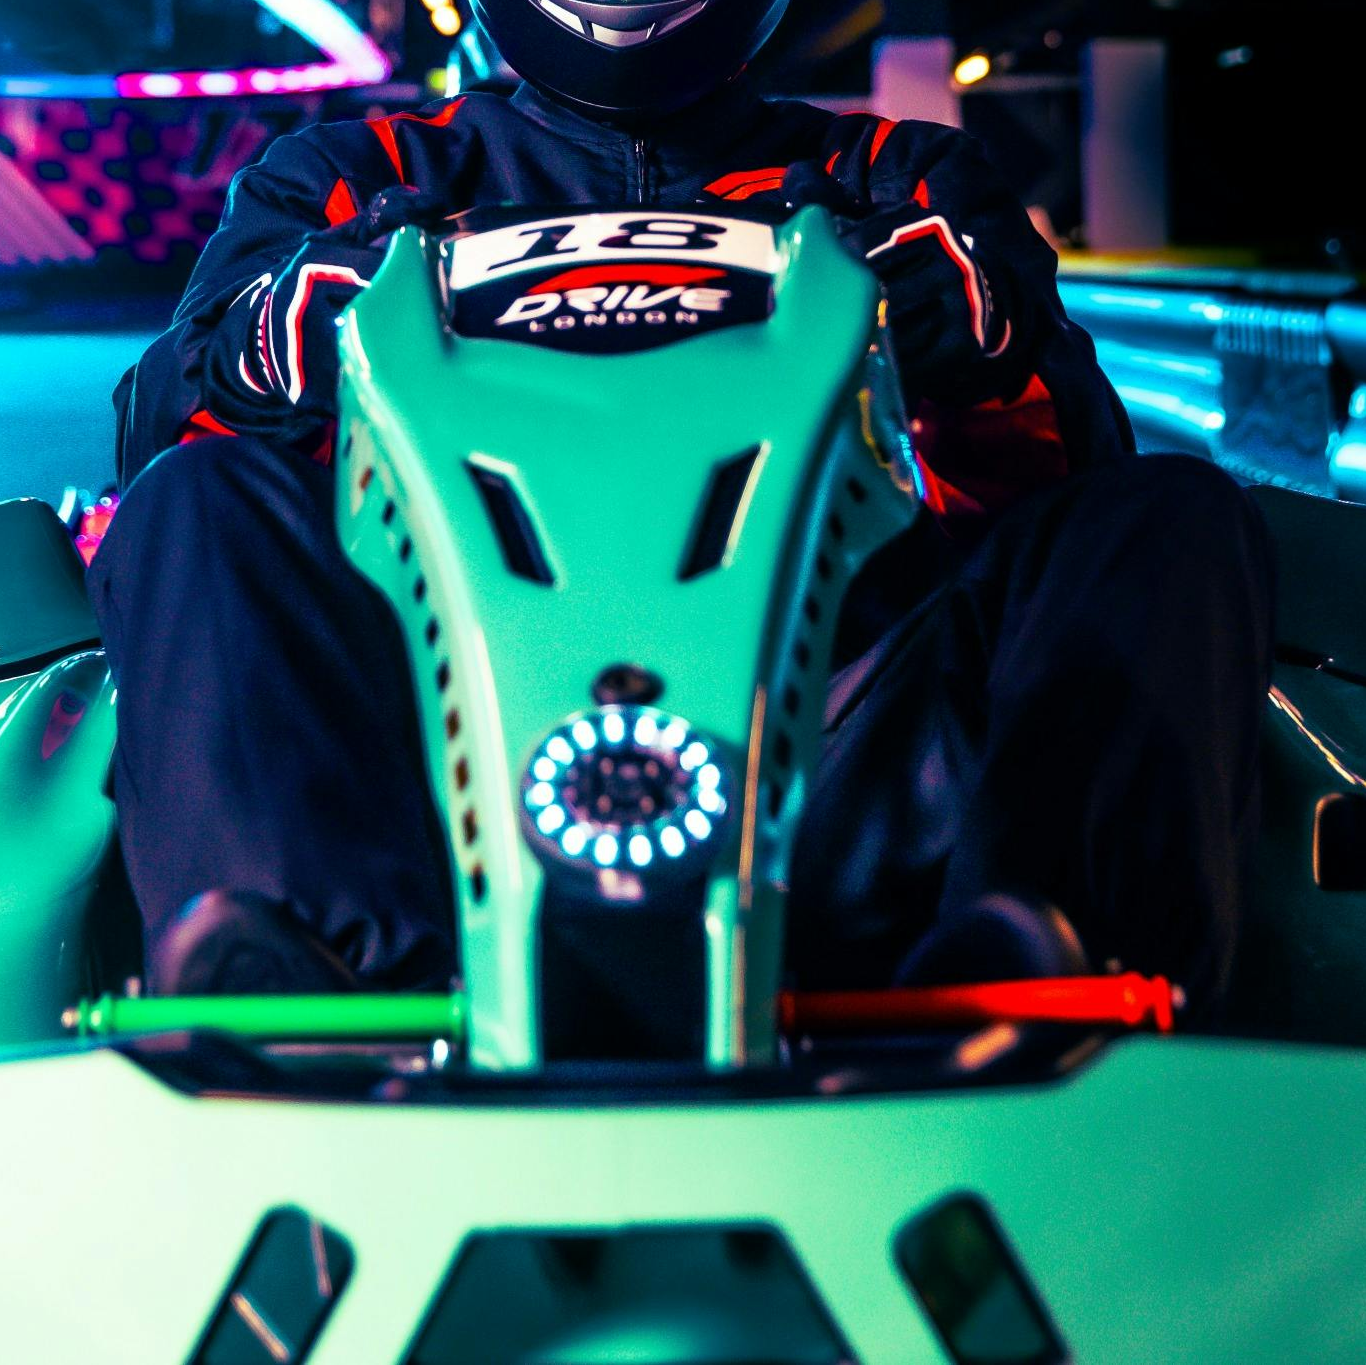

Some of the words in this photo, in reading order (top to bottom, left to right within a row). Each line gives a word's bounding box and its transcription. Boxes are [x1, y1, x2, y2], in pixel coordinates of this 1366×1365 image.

[487, 219, 728, 271] 18
[494, 285, 732, 326] DRIVE
[529, 311, 699, 332] LONDON
